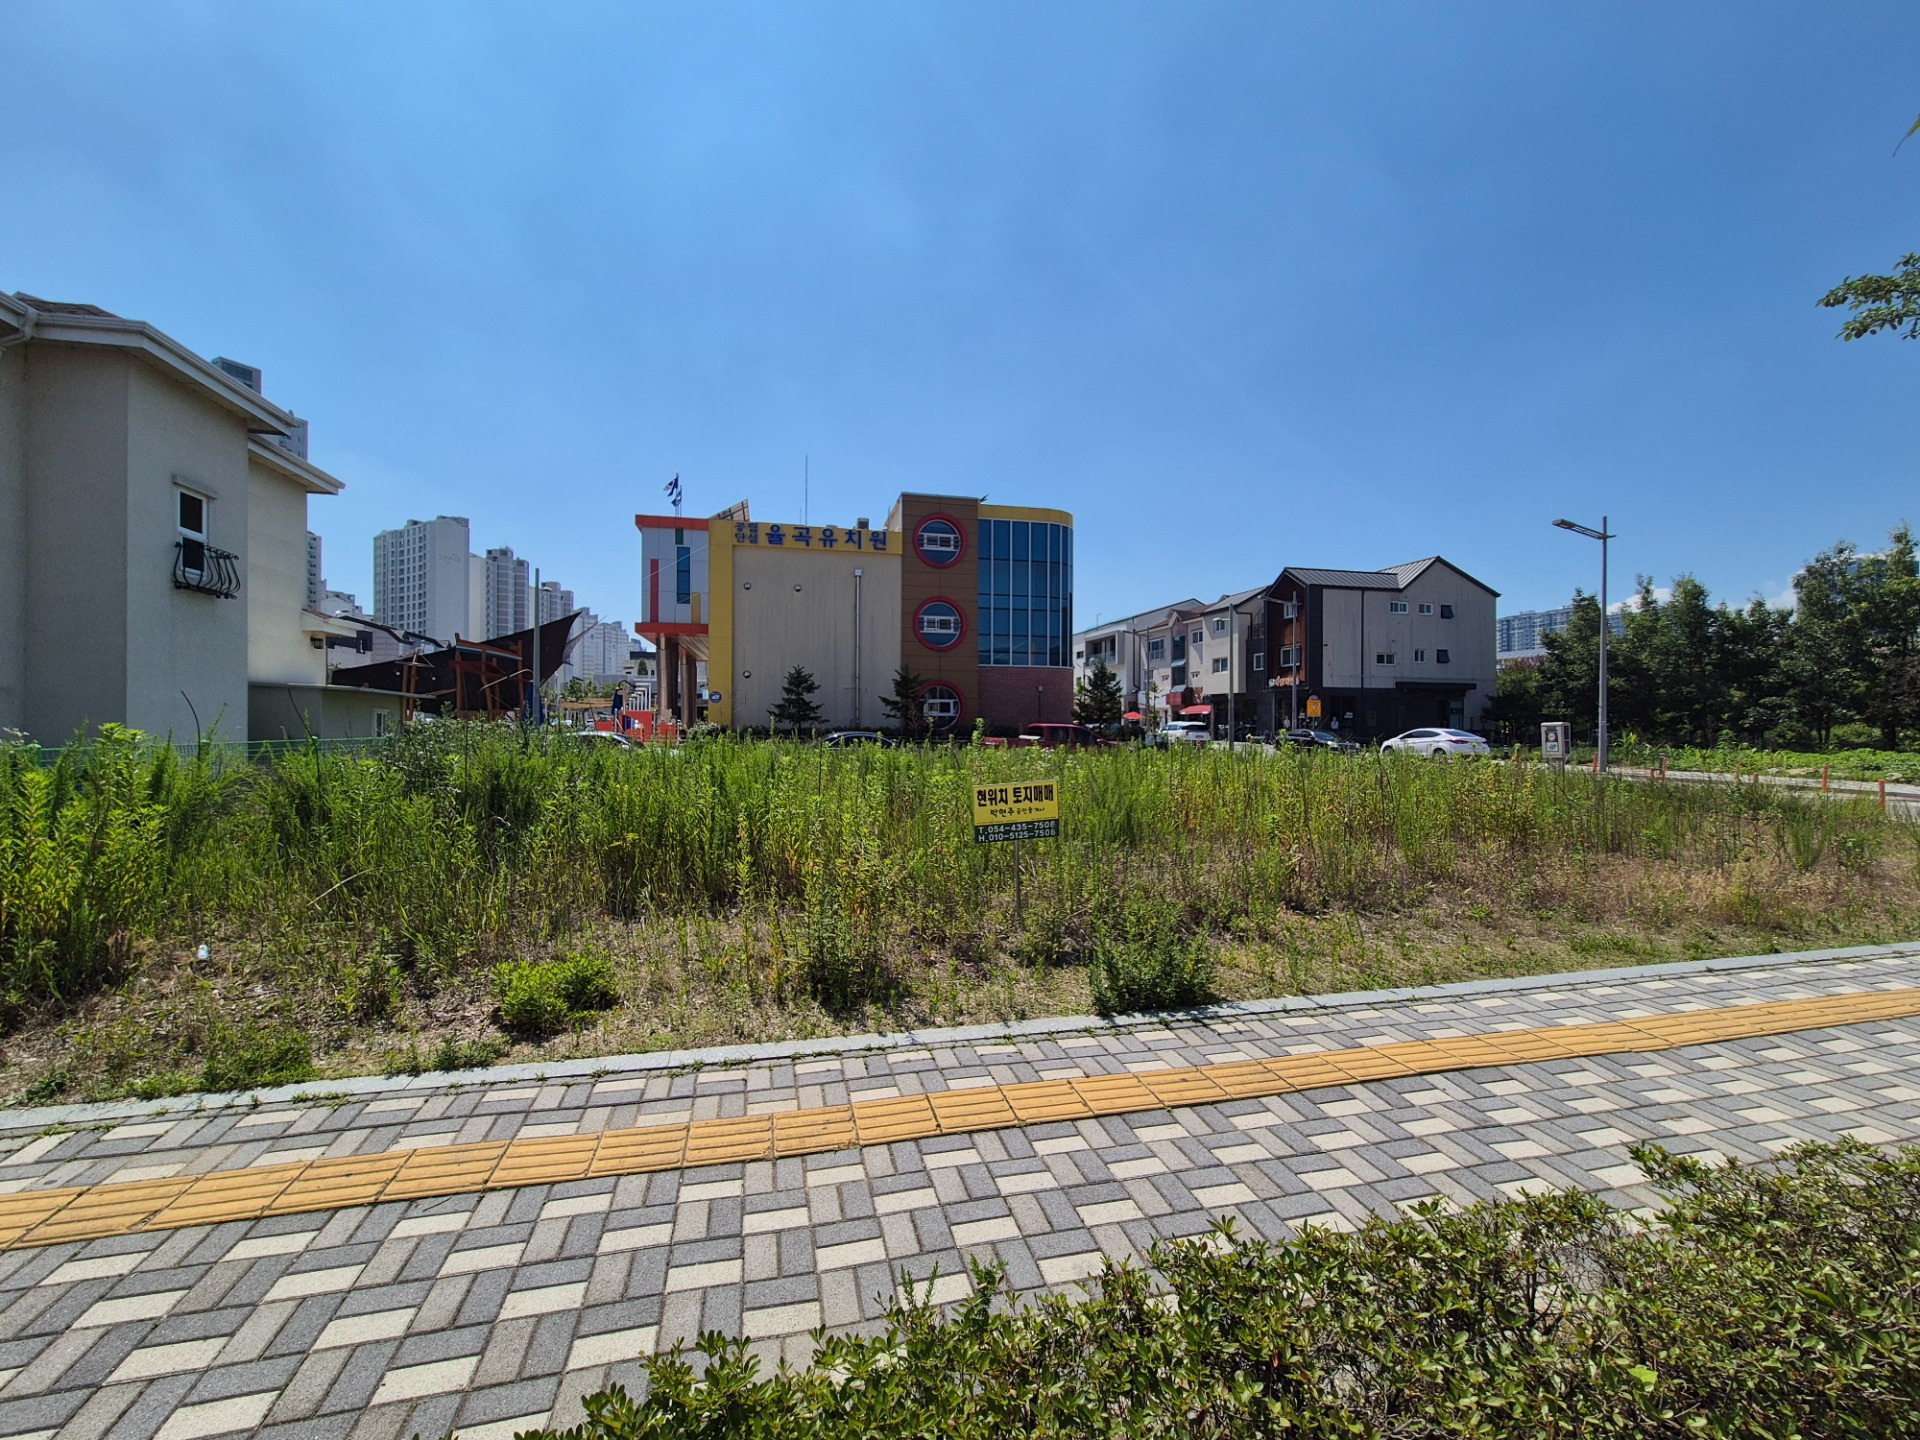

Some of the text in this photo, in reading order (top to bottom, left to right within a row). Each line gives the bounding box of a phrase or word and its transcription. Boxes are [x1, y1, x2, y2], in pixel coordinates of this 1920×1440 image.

[765, 524, 888, 551] 율곡유치원
[977, 784, 1054, 807] 현위치 토지매매
